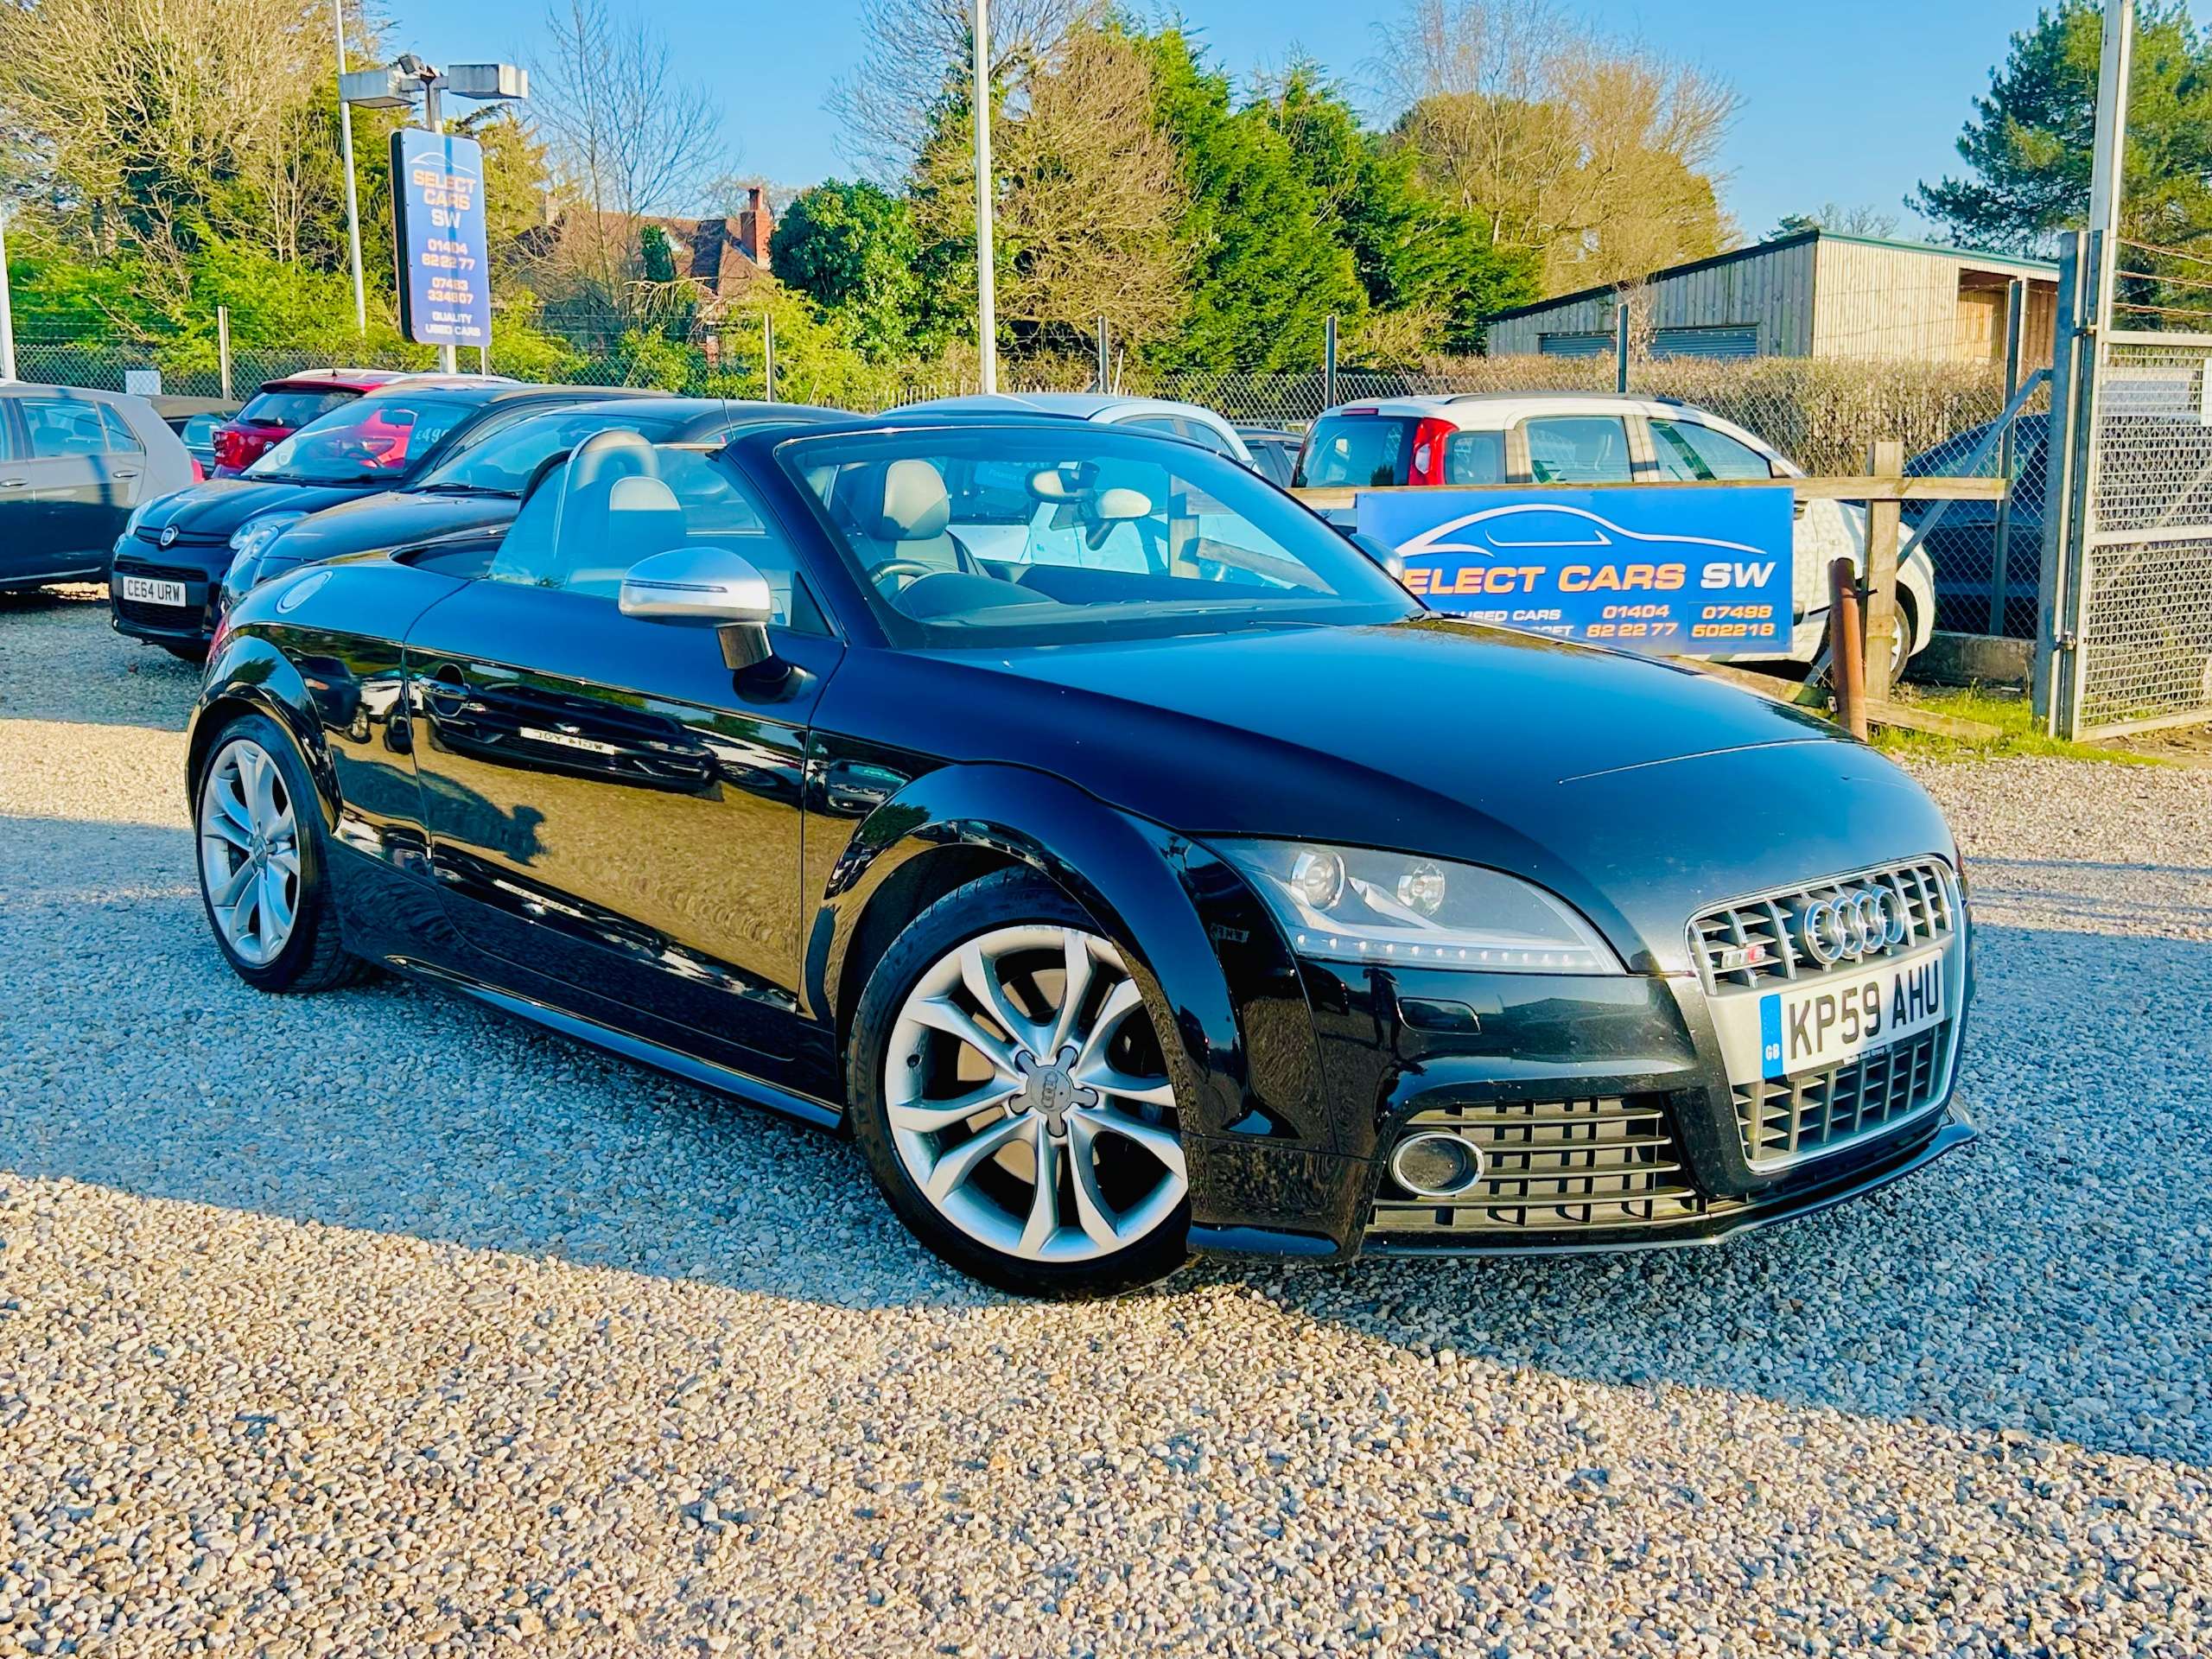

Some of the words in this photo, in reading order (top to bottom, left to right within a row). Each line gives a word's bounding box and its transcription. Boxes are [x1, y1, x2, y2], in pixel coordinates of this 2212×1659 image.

[413, 169, 476, 194] SELECT
[423, 188, 471, 211] CARS
[431, 208, 461, 229] SW
[428, 238, 467, 255] 01404
[459, 257, 475, 270] 77
[432, 311, 473, 324] QUALITY
[1402, 567, 1544, 595] ELECT
[1558, 563, 1686, 593] CARS
[1700, 562, 1777, 589] SW
[127, 579, 154, 598] CE64
[157, 582, 180, 601] URW
[1512, 609, 1561, 621] CARS
[1602, 604, 1670, 620] 01404
[1701, 605, 1773, 620] 07498
[1586, 624, 1615, 638] 82
[1618, 624, 1647, 638] 22
[1650, 621, 1679, 637] 77
[1691, 622, 1776, 638] 502218
[1789, 981, 1881, 1059] KP59
[1891, 960, 1939, 1029] AHU
[1764, 1043, 1781, 1061] GB
